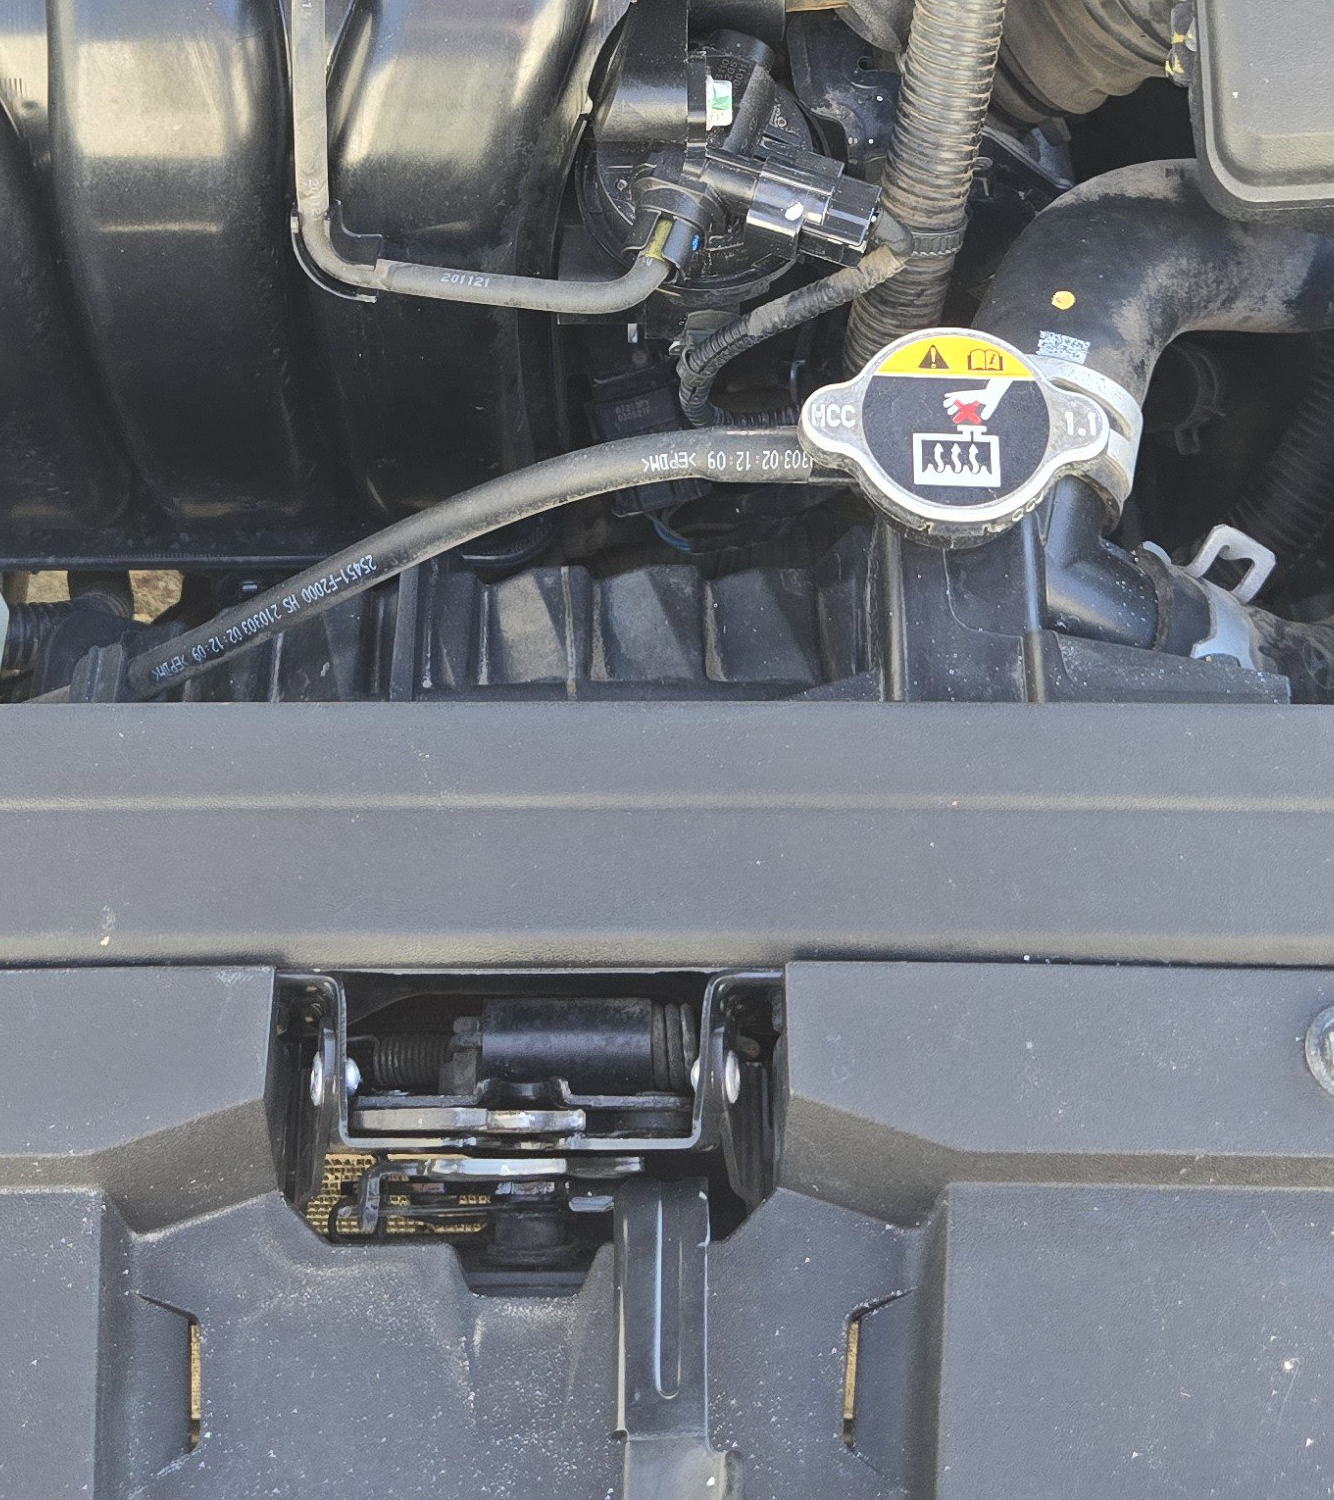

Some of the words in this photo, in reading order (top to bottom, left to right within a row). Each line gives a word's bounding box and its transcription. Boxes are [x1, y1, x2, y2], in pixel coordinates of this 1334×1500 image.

[440, 273, 490, 288] 201121
[1064, 411, 1097, 436] 1.1
[301, 554, 377, 603] 25451-F2000
[282, 594, 298, 614] HS
[241, 604, 282, 636] 210303
